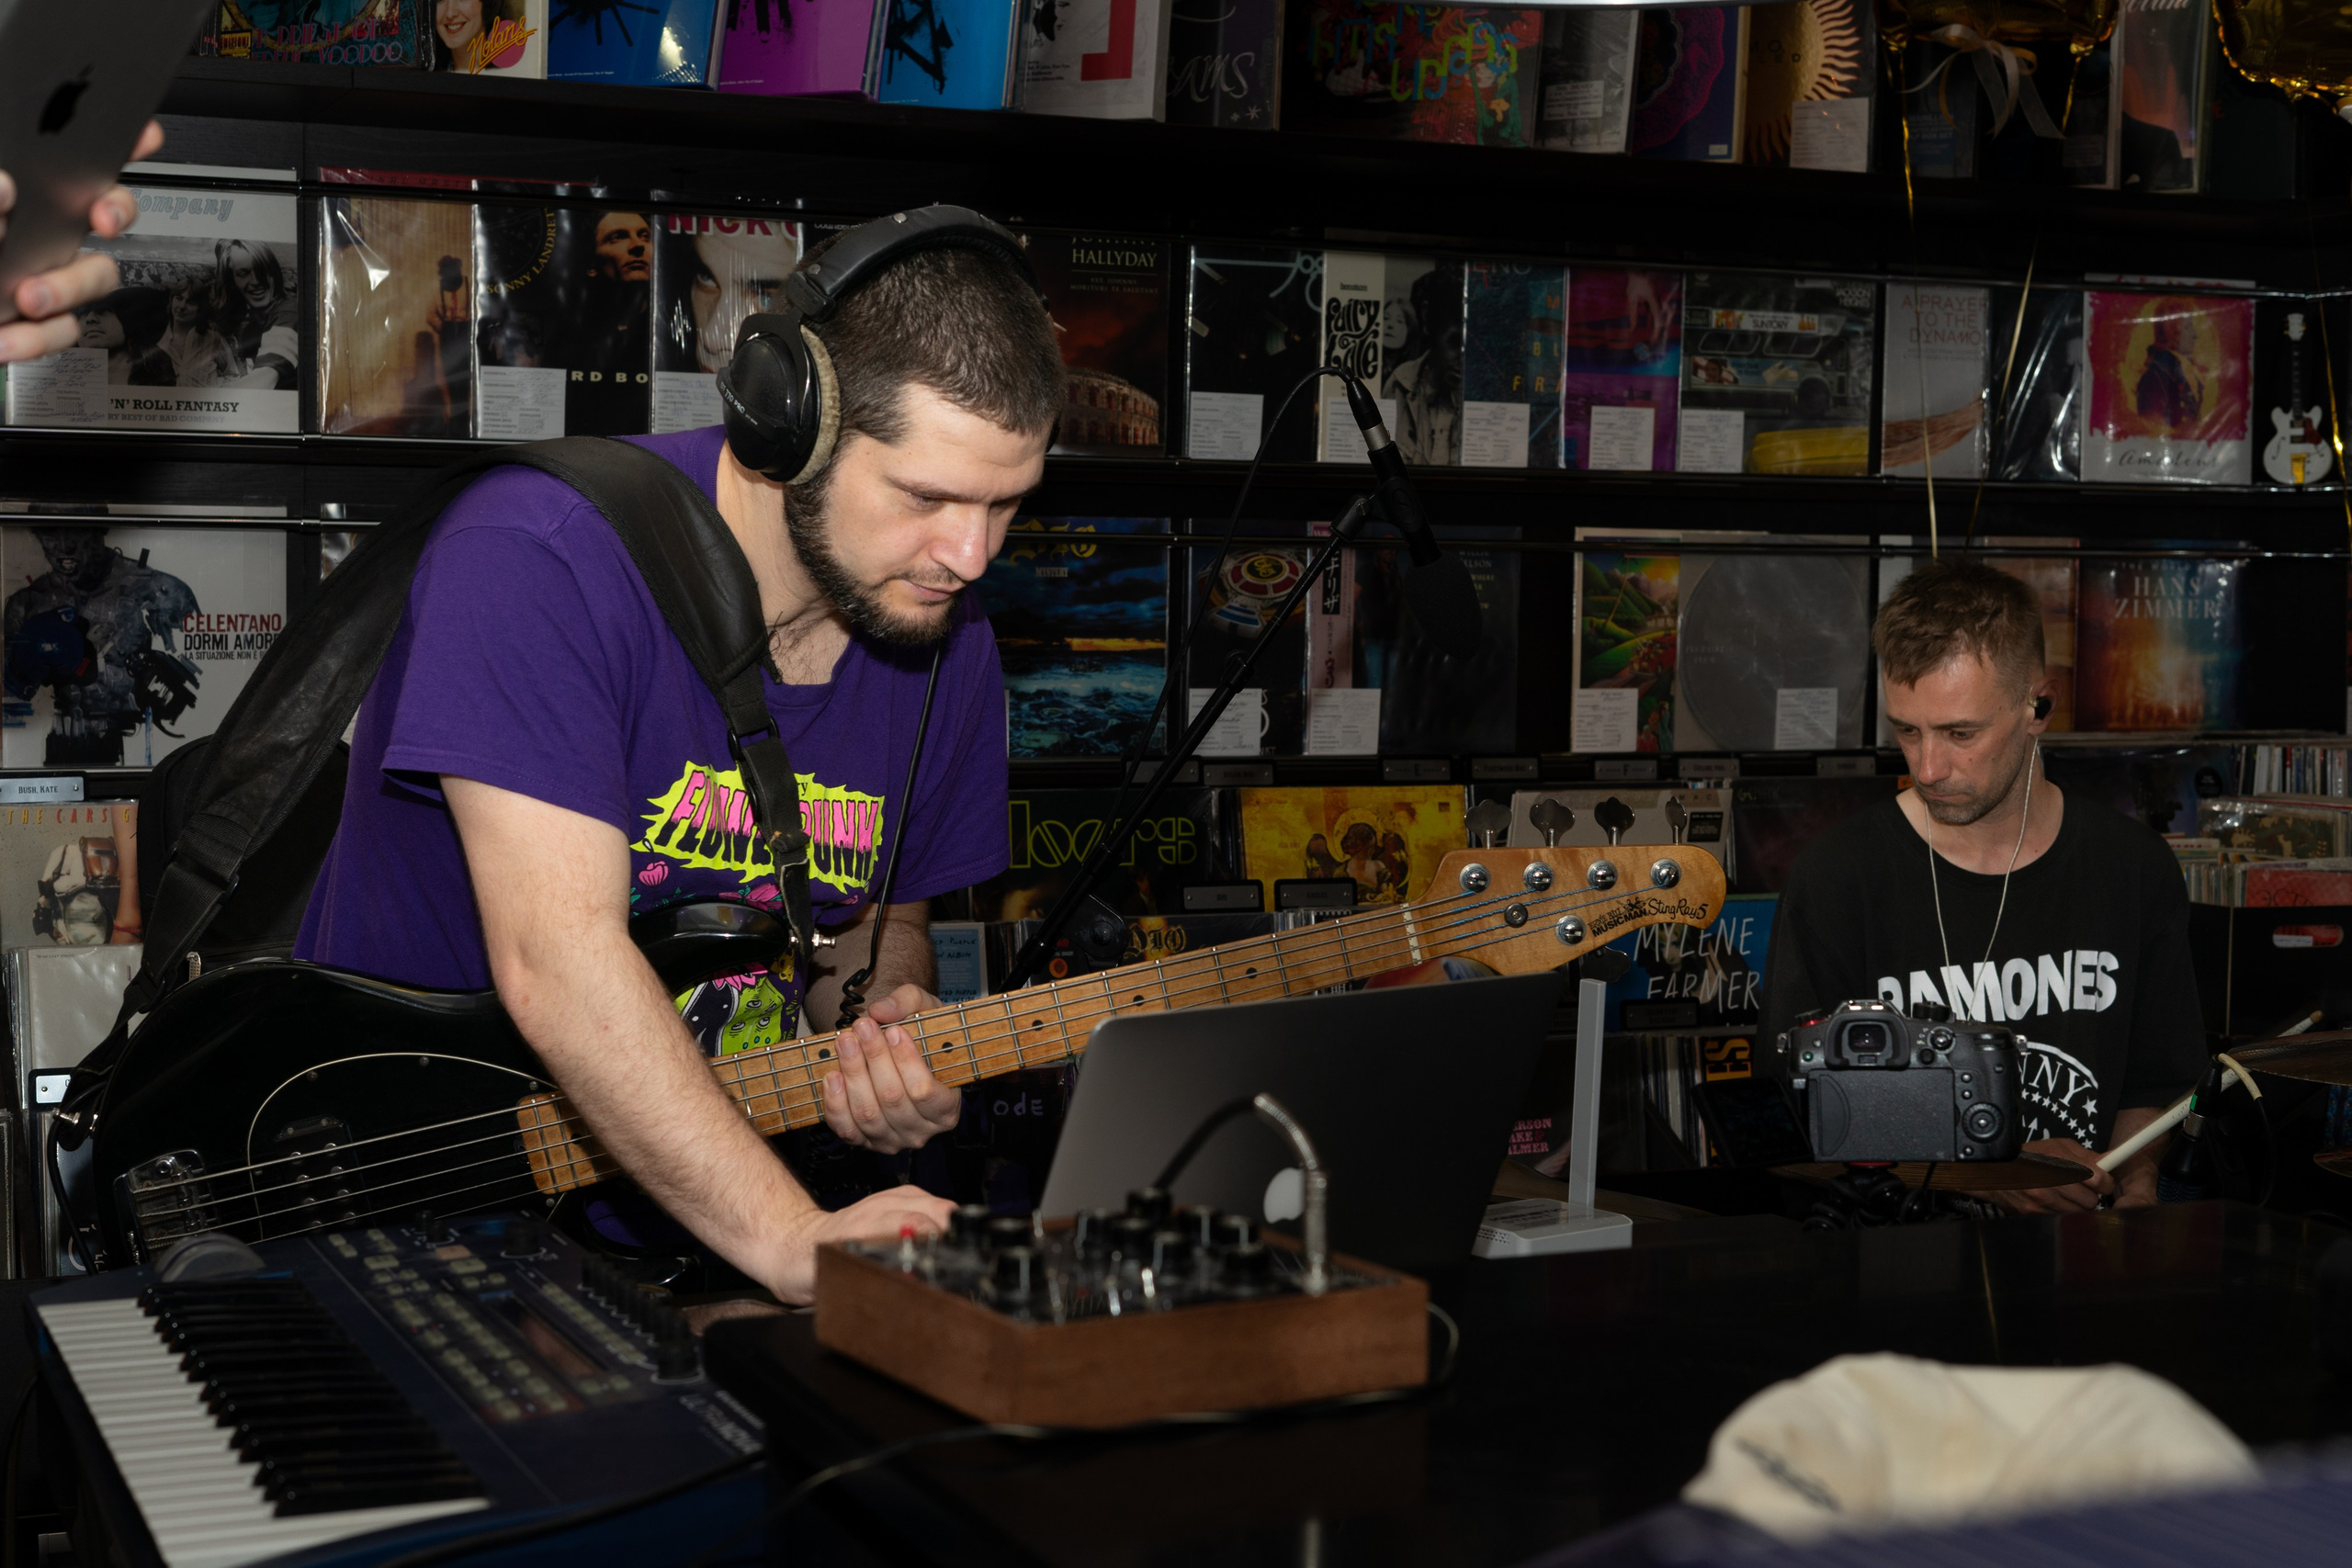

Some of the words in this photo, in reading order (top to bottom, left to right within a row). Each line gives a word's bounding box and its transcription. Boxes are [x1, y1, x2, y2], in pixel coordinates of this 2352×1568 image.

[318, 41, 403, 64] VOODOO
[467, 15, 535, 74] Nolans
[1072, 248, 1158, 267] HALLYDAY
[1901, 294, 1912, 309] A
[1751, 319, 1790, 330] SUNTORY
[1943, 311, 1976, 329] THE
[1909, 326, 1983, 346] DYNAMO
[132, 400, 173, 411] ROLL
[175, 400, 240, 412] FANTASY
[1035, 567, 1069, 577] MYSTERY
[2134, 576, 2201, 597] HANS
[2114, 597, 2219, 619] ZIMMER
[183, 613, 282, 633] CELENTANO
[184, 634, 228, 650] DORMI
[196, 651, 235, 660] SITUAZIONE
[237, 650, 251, 660] NON
[40, 785, 58, 794] KATE
[8, 807, 43, 825] THE
[56, 807, 108, 824] CARS
[1646, 969, 1761, 1014] FARMER
[1877, 949, 2120, 1023] RAMONES
